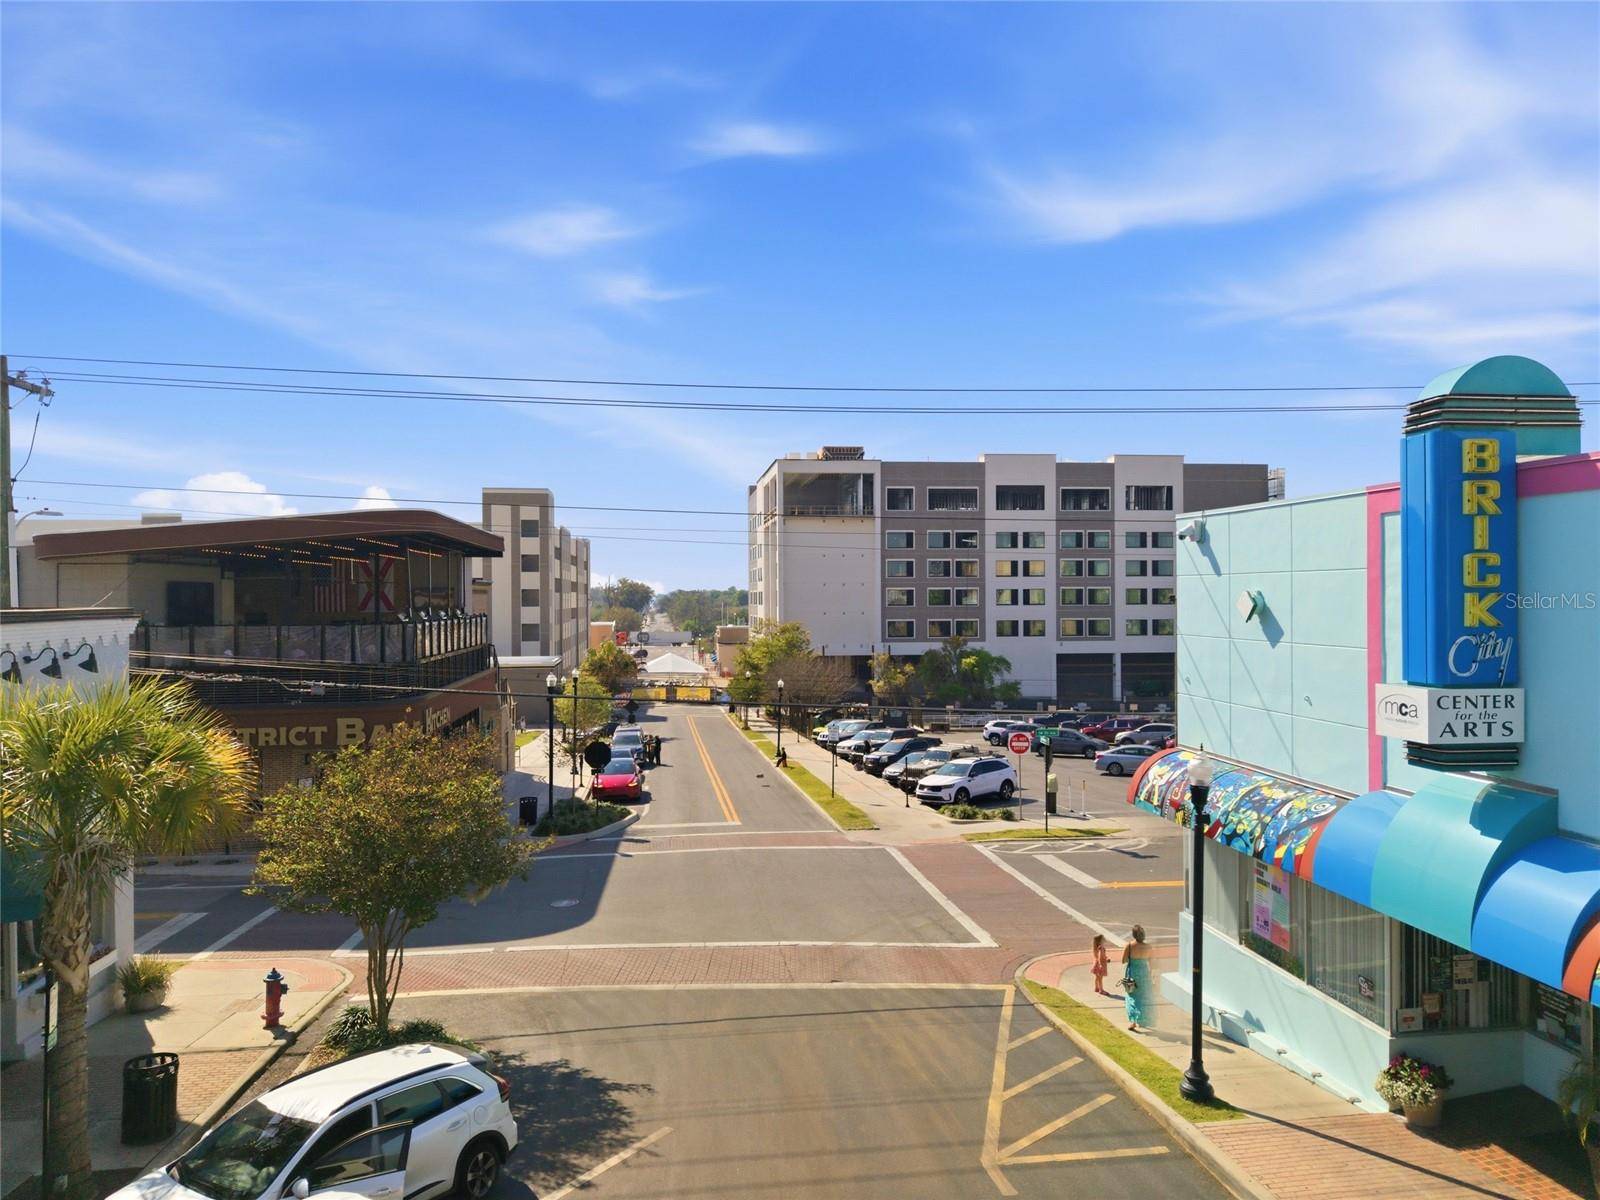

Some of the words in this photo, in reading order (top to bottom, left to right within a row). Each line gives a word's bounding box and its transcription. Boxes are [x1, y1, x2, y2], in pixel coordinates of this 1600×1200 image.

[1462, 438, 1504, 628] BRICK
[1448, 631, 1513, 687] City
[1384, 700, 1419, 719] mca
[1436, 694, 1516, 710] CENTER
[1454, 711, 1473, 721] for
[1478, 710, 1499, 720] the
[237, 726, 328, 746] TRICT
[1439, 721, 1515, 738] ARTS
